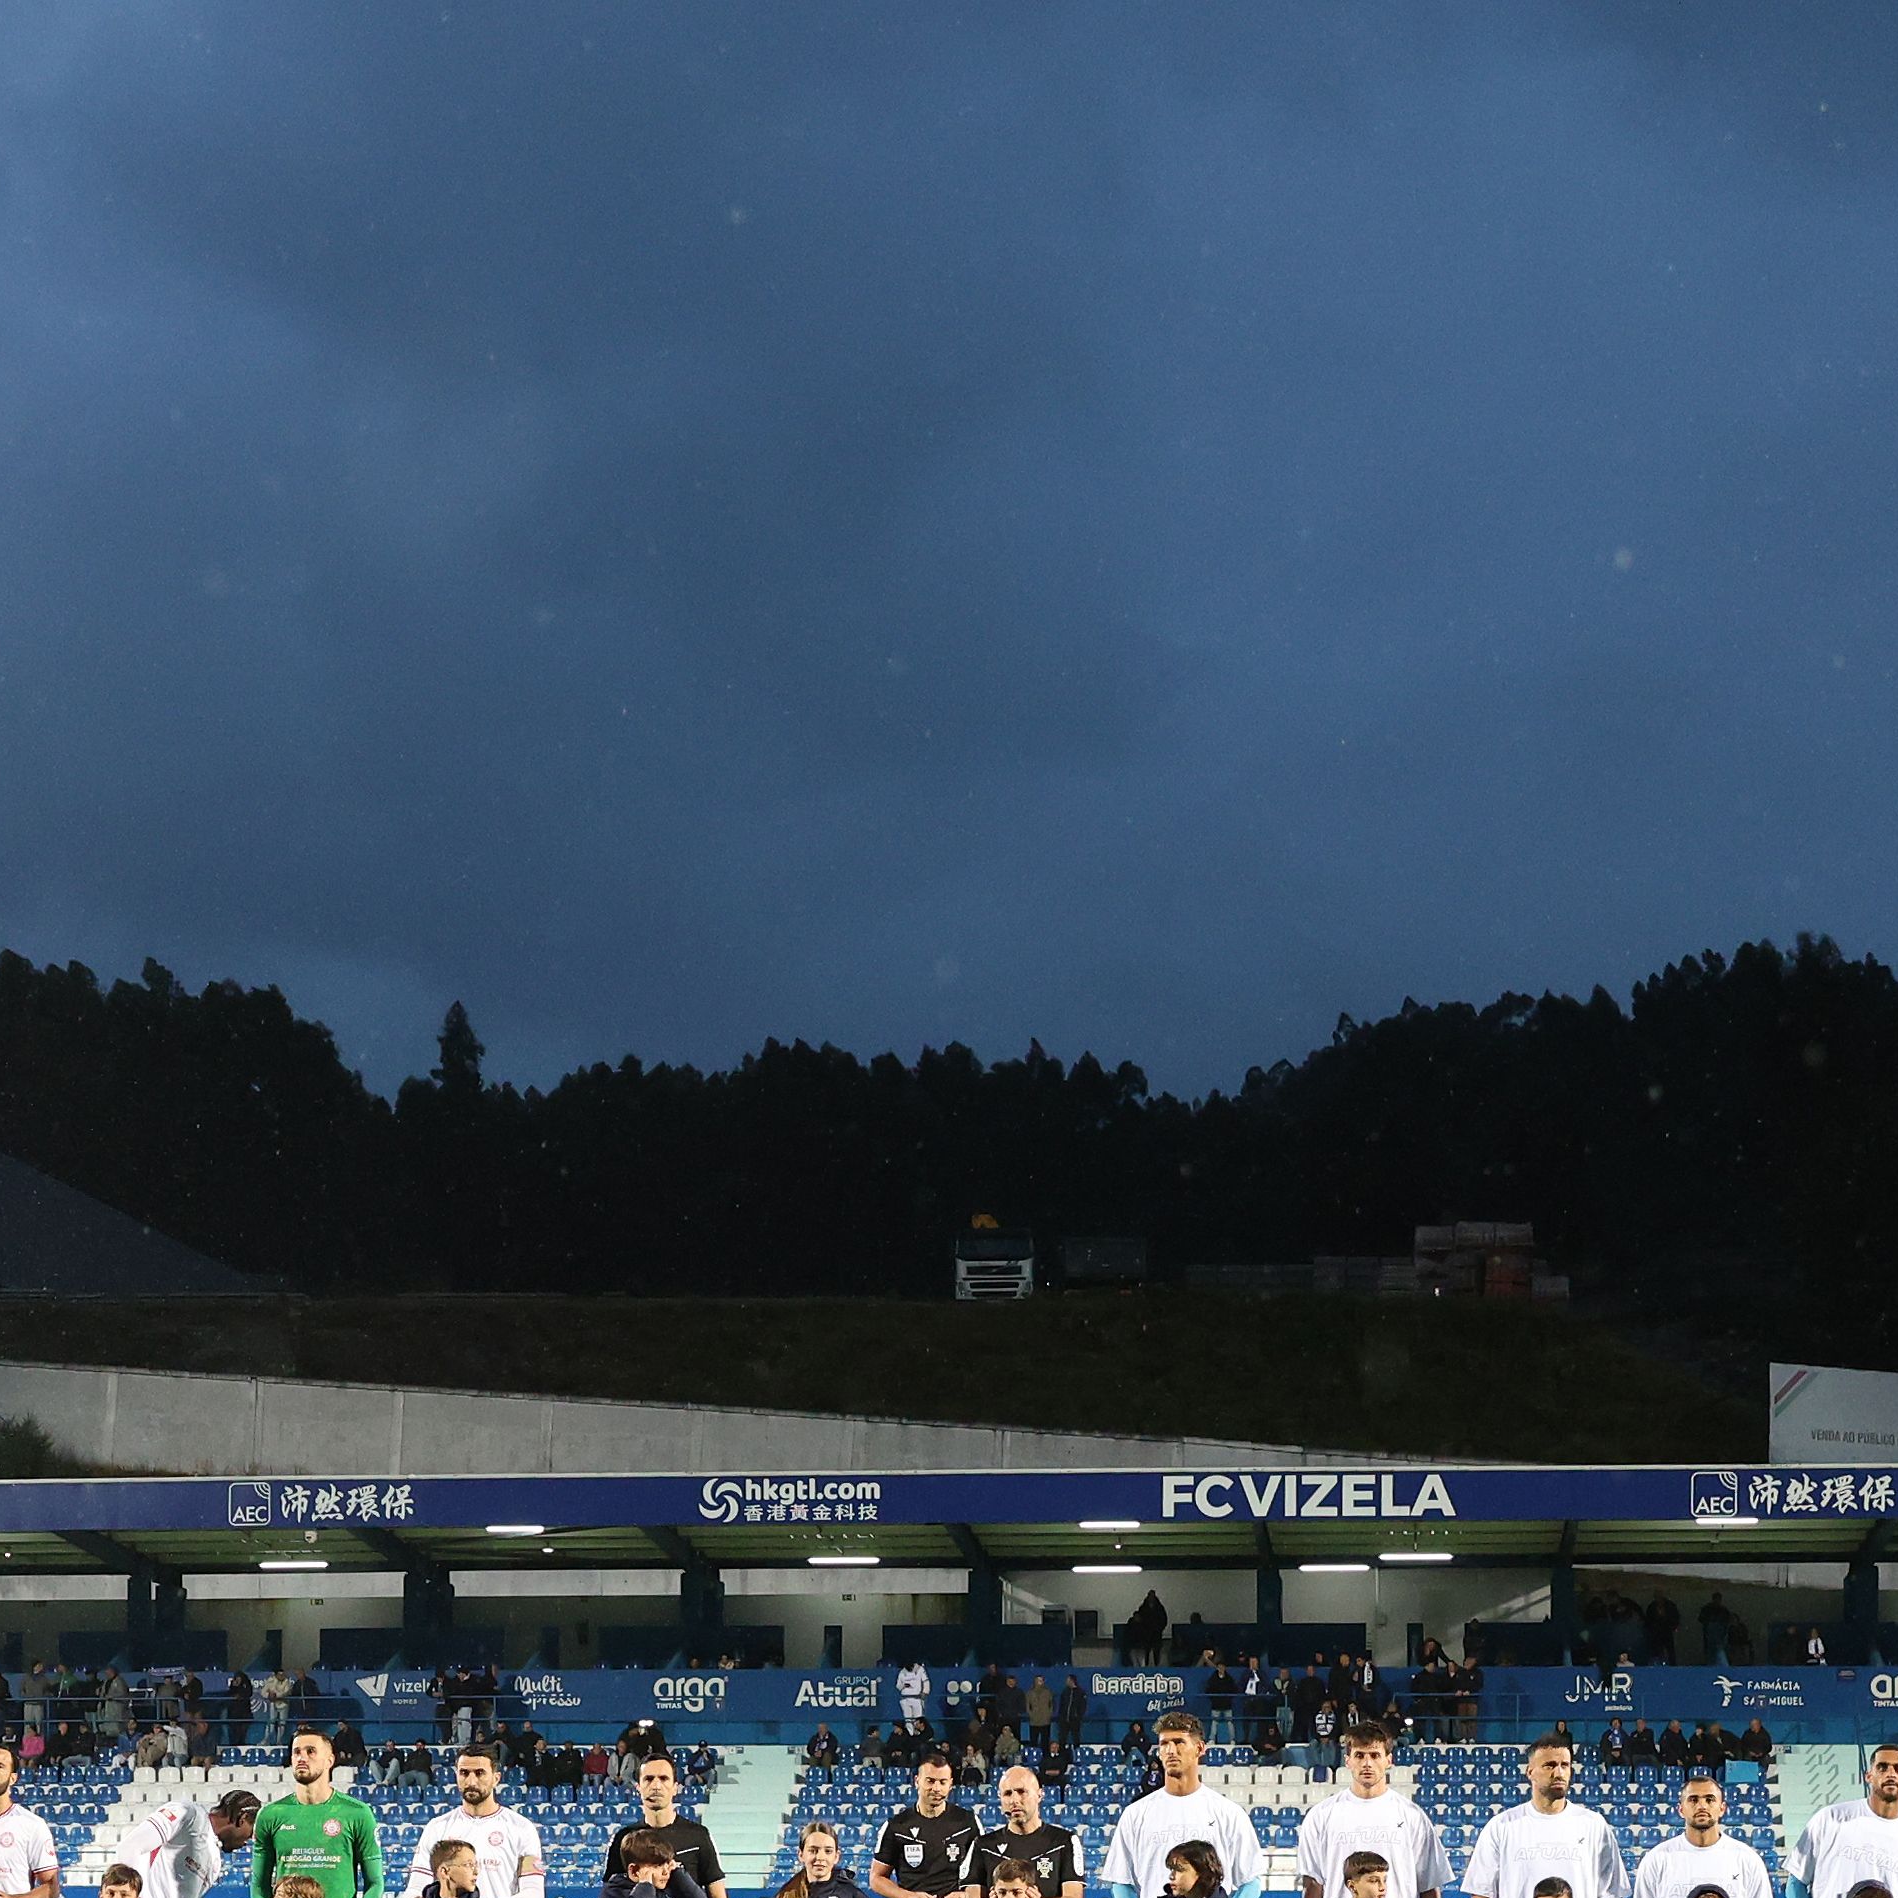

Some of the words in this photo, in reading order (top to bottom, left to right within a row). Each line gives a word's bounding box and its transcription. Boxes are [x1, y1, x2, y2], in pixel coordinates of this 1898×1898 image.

[1811, 1429, 1843, 1442] VENDA
[745, 1478, 881, 1505] hkgtl.com
[1695, 1497, 1734, 1515] AEC
[232, 1506, 268, 1523] AEC
[514, 1674, 563, 1696] Multi
[834, 1676, 870, 1686] GRUPO
[1747, 1678, 1800, 1691] FARMÁCIA
[653, 1676, 728, 1713] arga
[794, 1680, 877, 1708] Atual
[1768, 1696, 1805, 1707] MIGUEL
[1337, 1830, 1402, 1845] ATUAL
[1514, 1847, 1583, 1862] ATUAL
